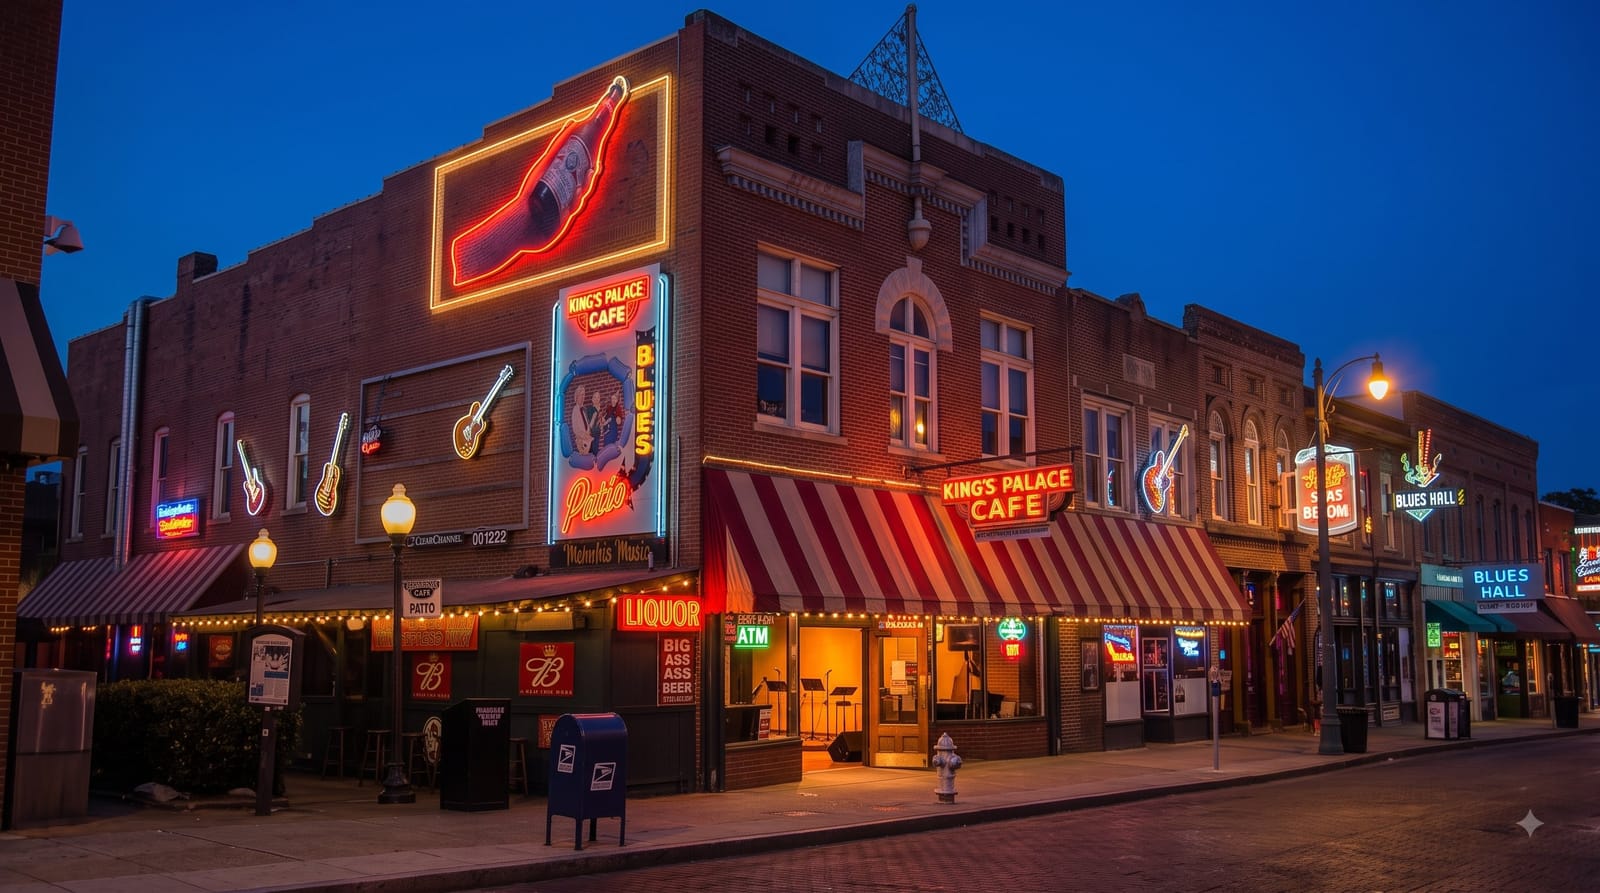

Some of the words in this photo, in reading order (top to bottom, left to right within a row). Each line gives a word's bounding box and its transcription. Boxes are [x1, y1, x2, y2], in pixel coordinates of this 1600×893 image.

[569, 291, 602, 314] KING'S
[604, 280, 644, 304] PALACE
[589, 305, 625, 329] CAFE
[635, 344, 653, 455] BLUES
[943, 478, 996, 500] KING'S
[1002, 469, 1072, 493] PALACE
[561, 475, 626, 534] Patio
[971, 493, 1042, 520] CAFE
[1395, 492, 1427, 508] BLUES
[1429, 490, 1456, 506] HALL
[472, 530, 507, 546] 001222
[1473, 568, 1529, 584] BLUES
[1481, 585, 1526, 599] HALL
[626, 598, 700, 627] LIQUOR
[737, 627, 768, 644] ATM
[663, 639, 691, 652] BIG
[664, 653, 691, 666] ASS
[663, 667, 692, 680] ASS
[662, 682, 692, 693] BEER
